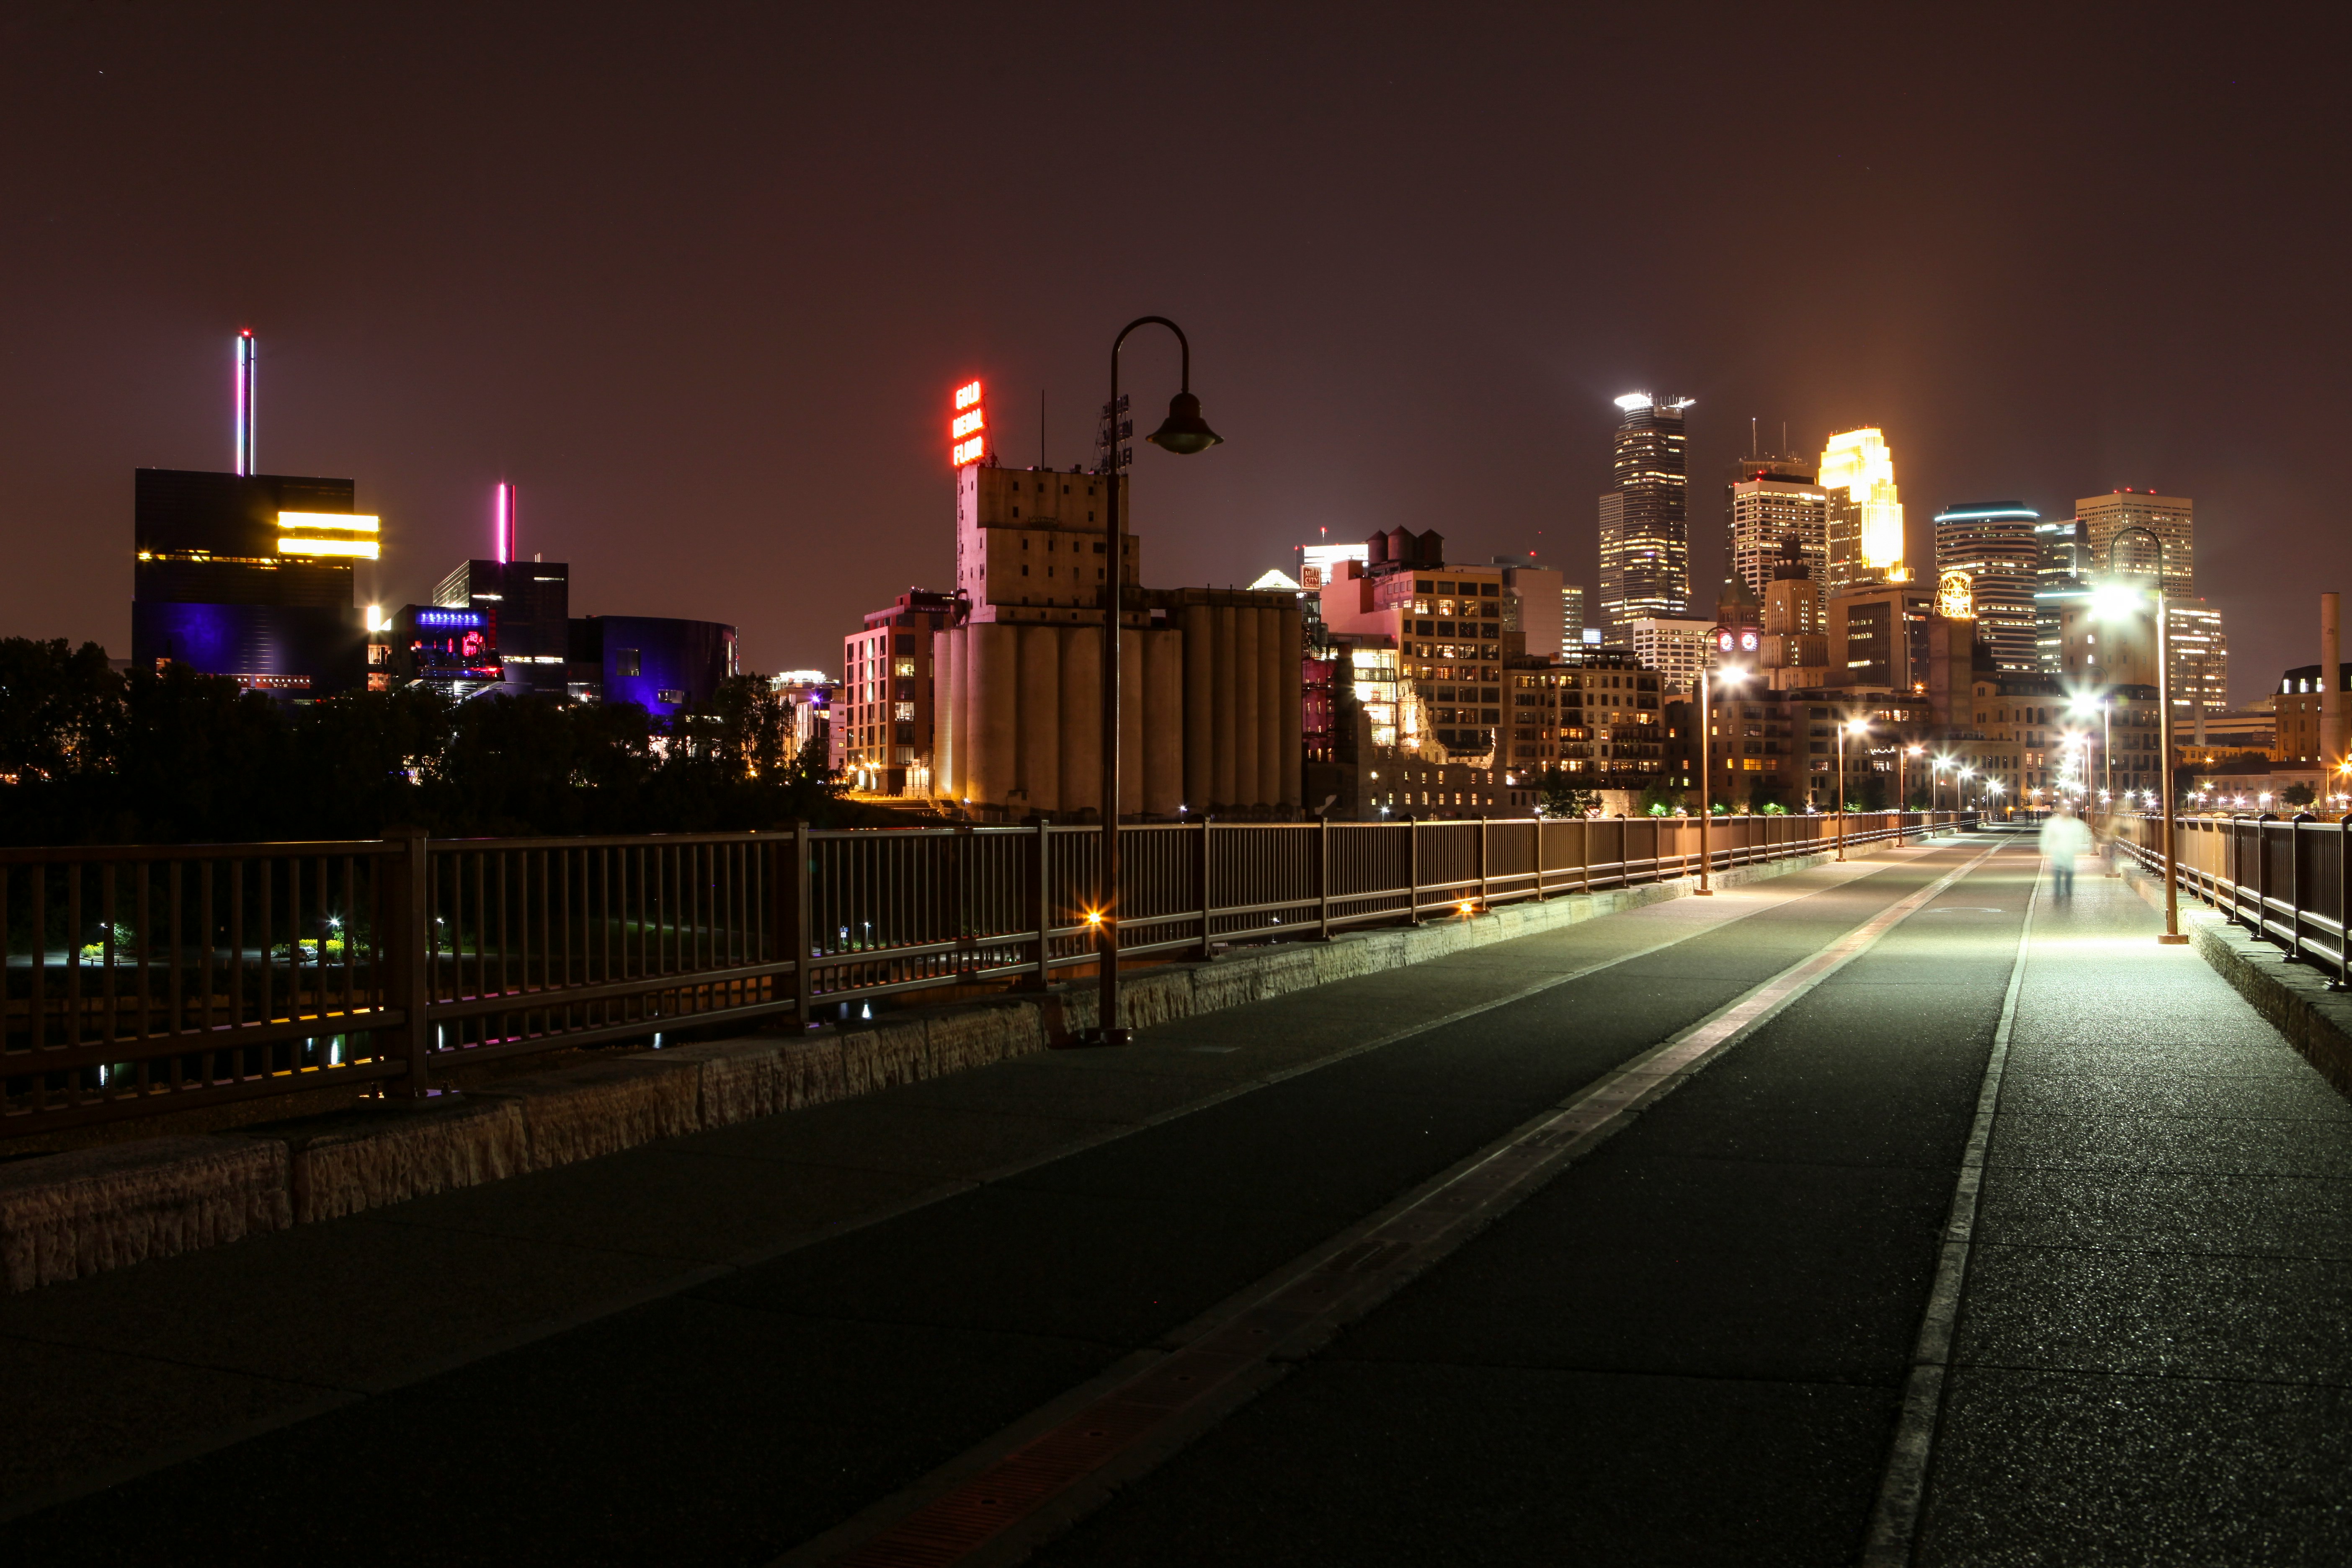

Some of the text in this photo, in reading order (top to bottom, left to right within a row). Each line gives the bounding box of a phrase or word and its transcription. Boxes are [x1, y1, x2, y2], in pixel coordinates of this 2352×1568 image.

[956, 381, 980, 410] GOLD
[953, 408, 983, 438] MEDAL
[954, 436, 982, 466] FLOUR
